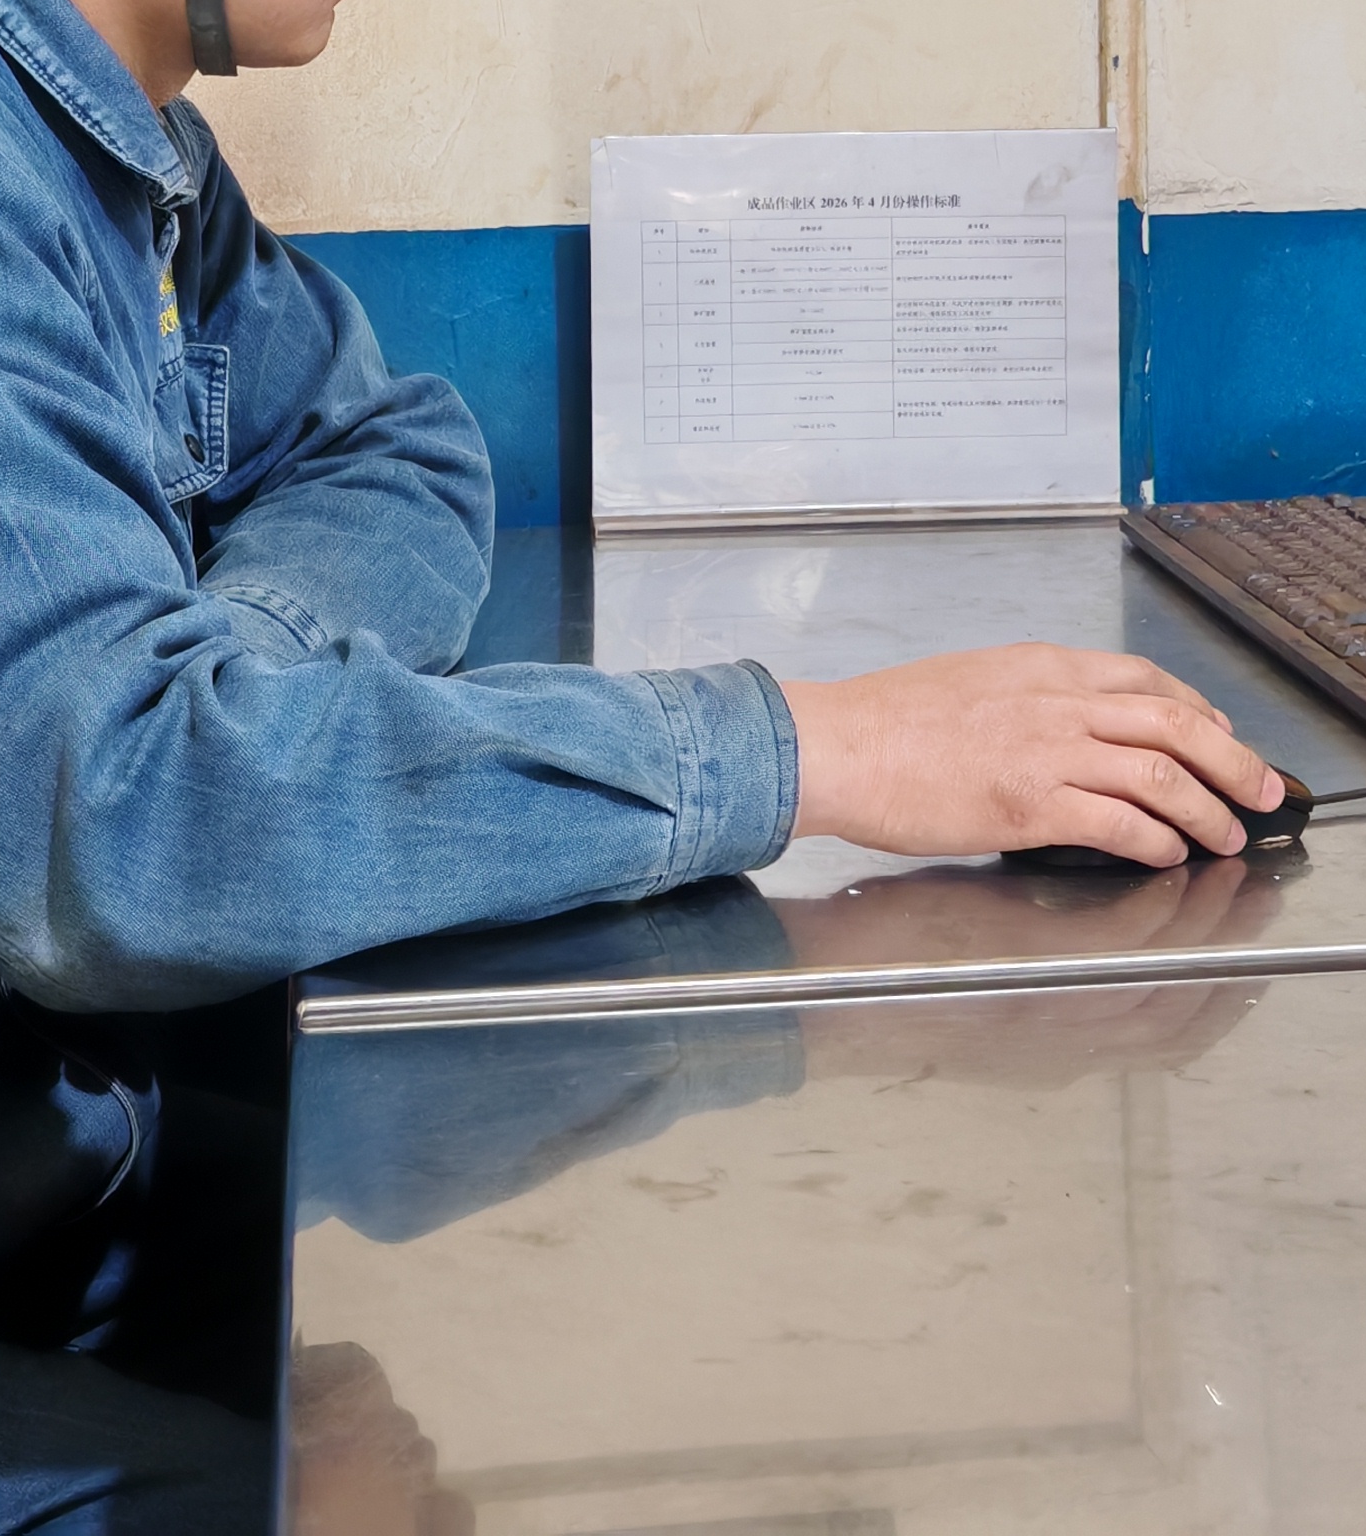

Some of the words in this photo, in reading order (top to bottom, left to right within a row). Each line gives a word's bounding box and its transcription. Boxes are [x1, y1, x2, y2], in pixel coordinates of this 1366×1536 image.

[747, 196, 816, 211] 成品作业区
[820, 197, 848, 209] 2026
[852, 195, 865, 210] 年
[868, 197, 875, 208] 4
